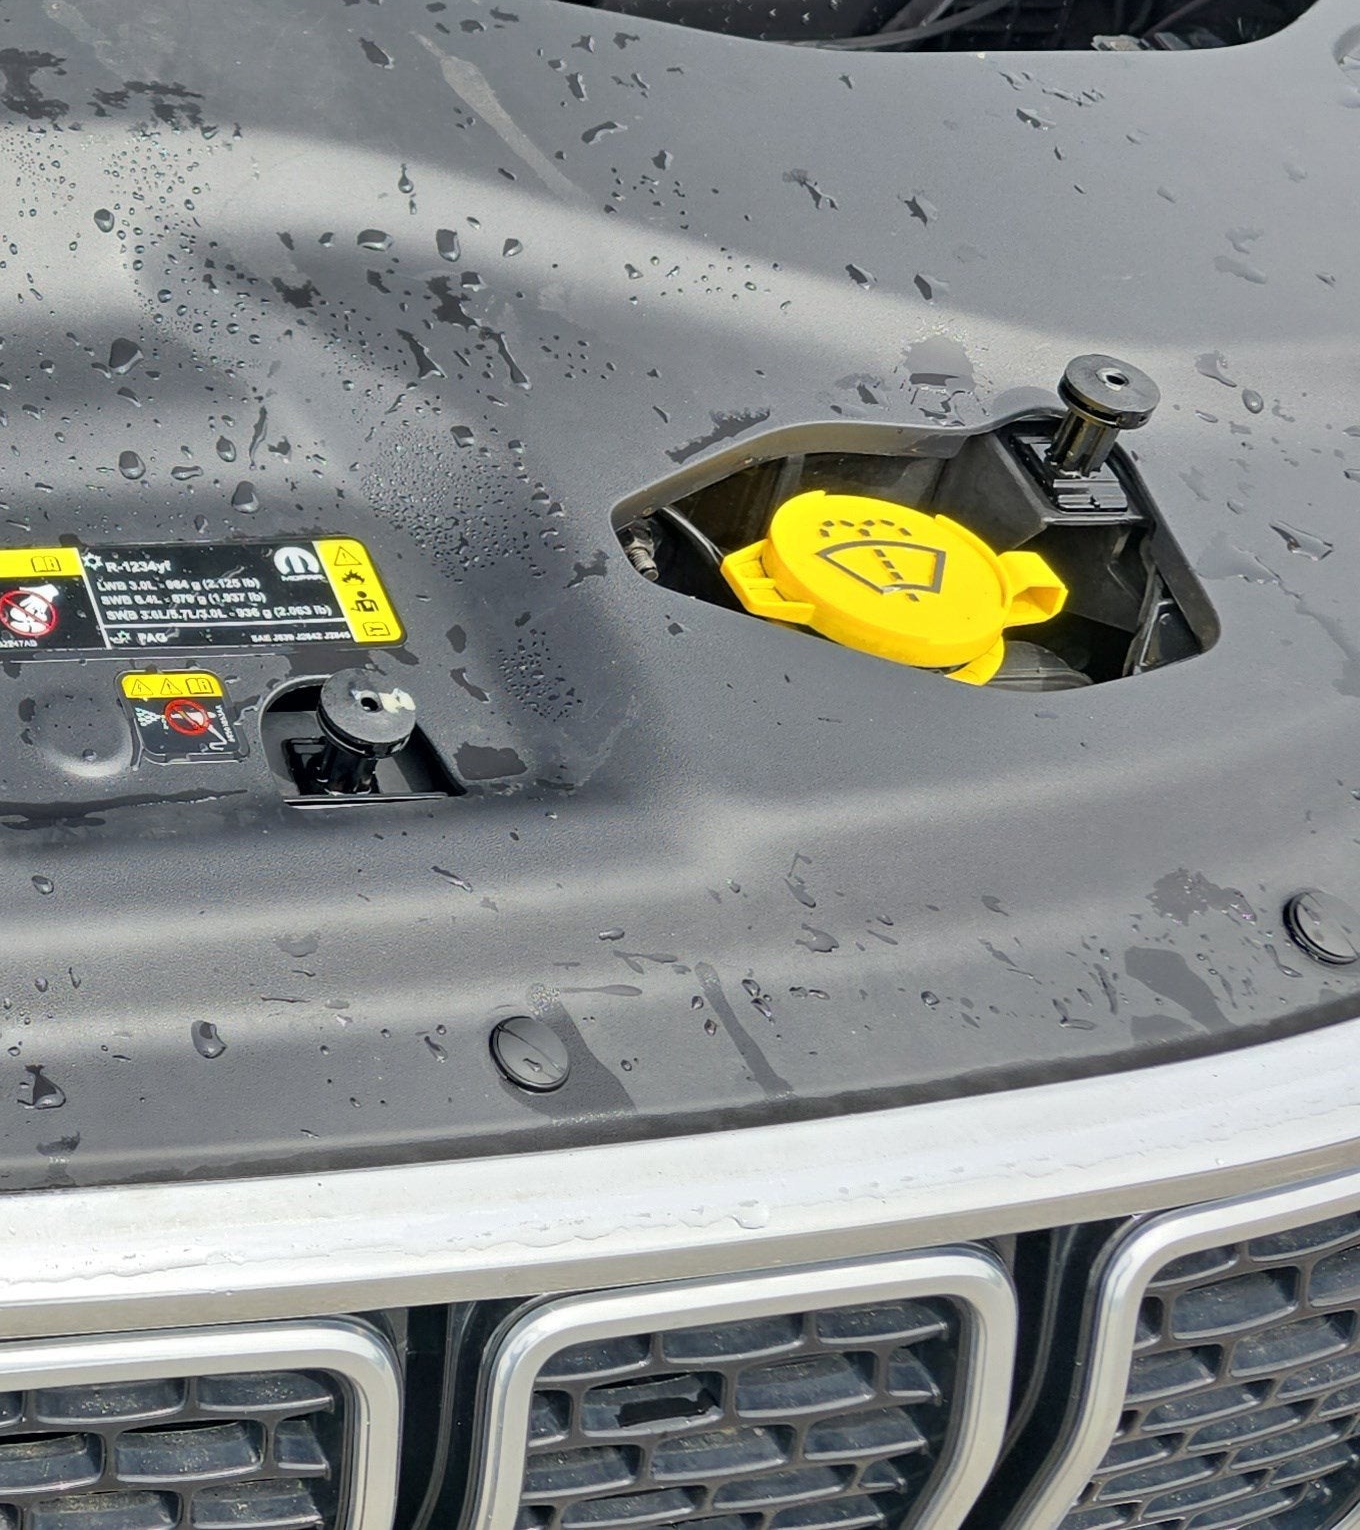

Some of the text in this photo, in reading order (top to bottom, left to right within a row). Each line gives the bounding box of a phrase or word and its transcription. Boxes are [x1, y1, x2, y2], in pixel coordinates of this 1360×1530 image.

[105, 561, 171, 575] R-1234yf
[242, 578, 260, 589] lb)
[248, 591, 266, 605] lb)
[313, 605, 332, 617] lb)
